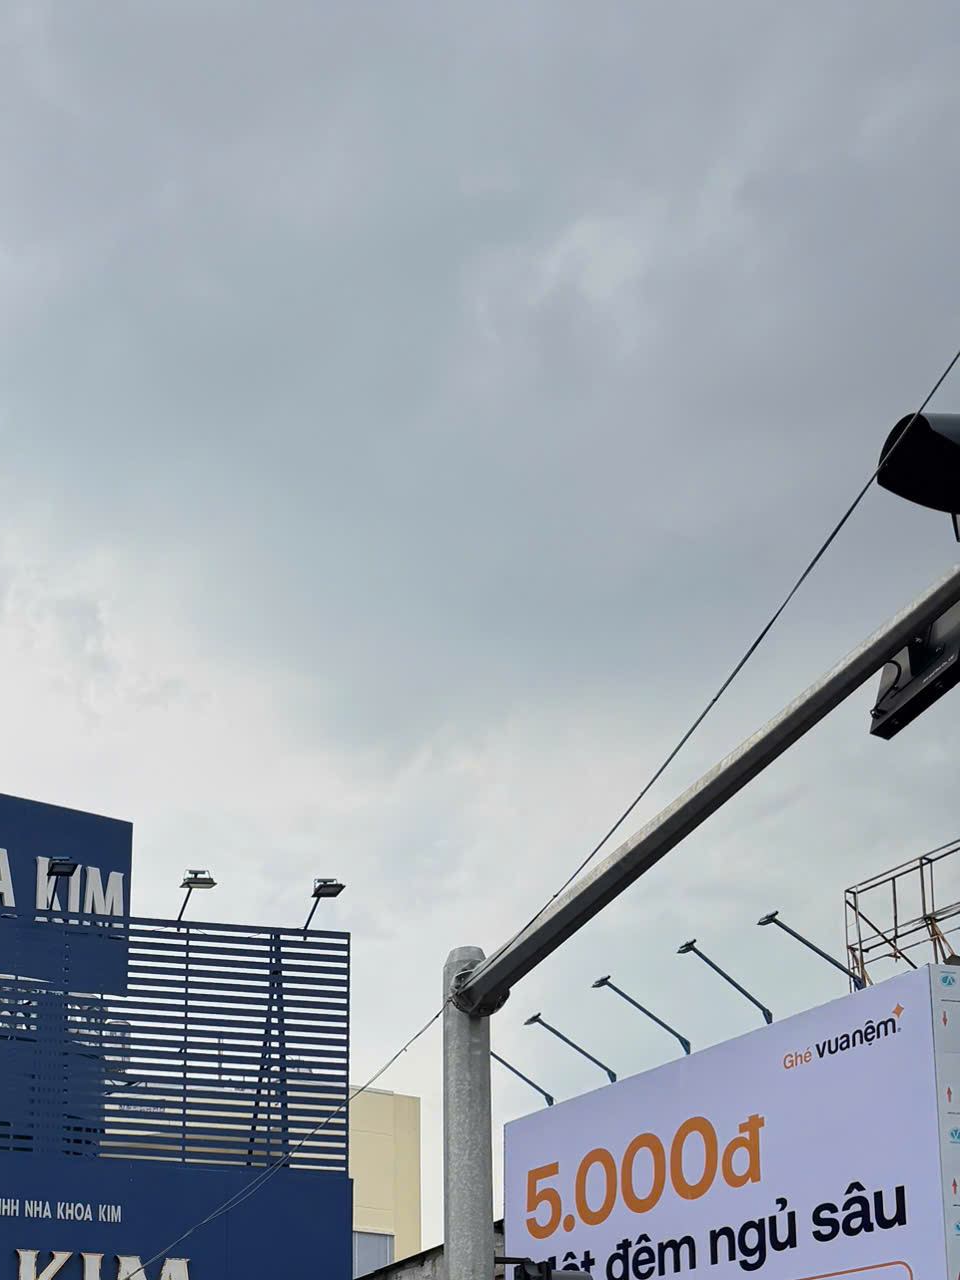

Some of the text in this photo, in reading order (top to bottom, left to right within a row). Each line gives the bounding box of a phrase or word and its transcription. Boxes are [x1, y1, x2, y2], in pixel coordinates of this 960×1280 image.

[35, 856, 125, 917] KIM
[783, 1017, 897, 1070] Ghé vuanệm
[525, 1114, 765, 1240] 5.000đ
[25, 1200, 52, 1219] NHA
[57, 1202, 92, 1222] KHOA
[98, 1204, 122, 1223] KIM
[709, 1197, 798, 1272] ngủ
[811, 1181, 908, 1243] sâu
